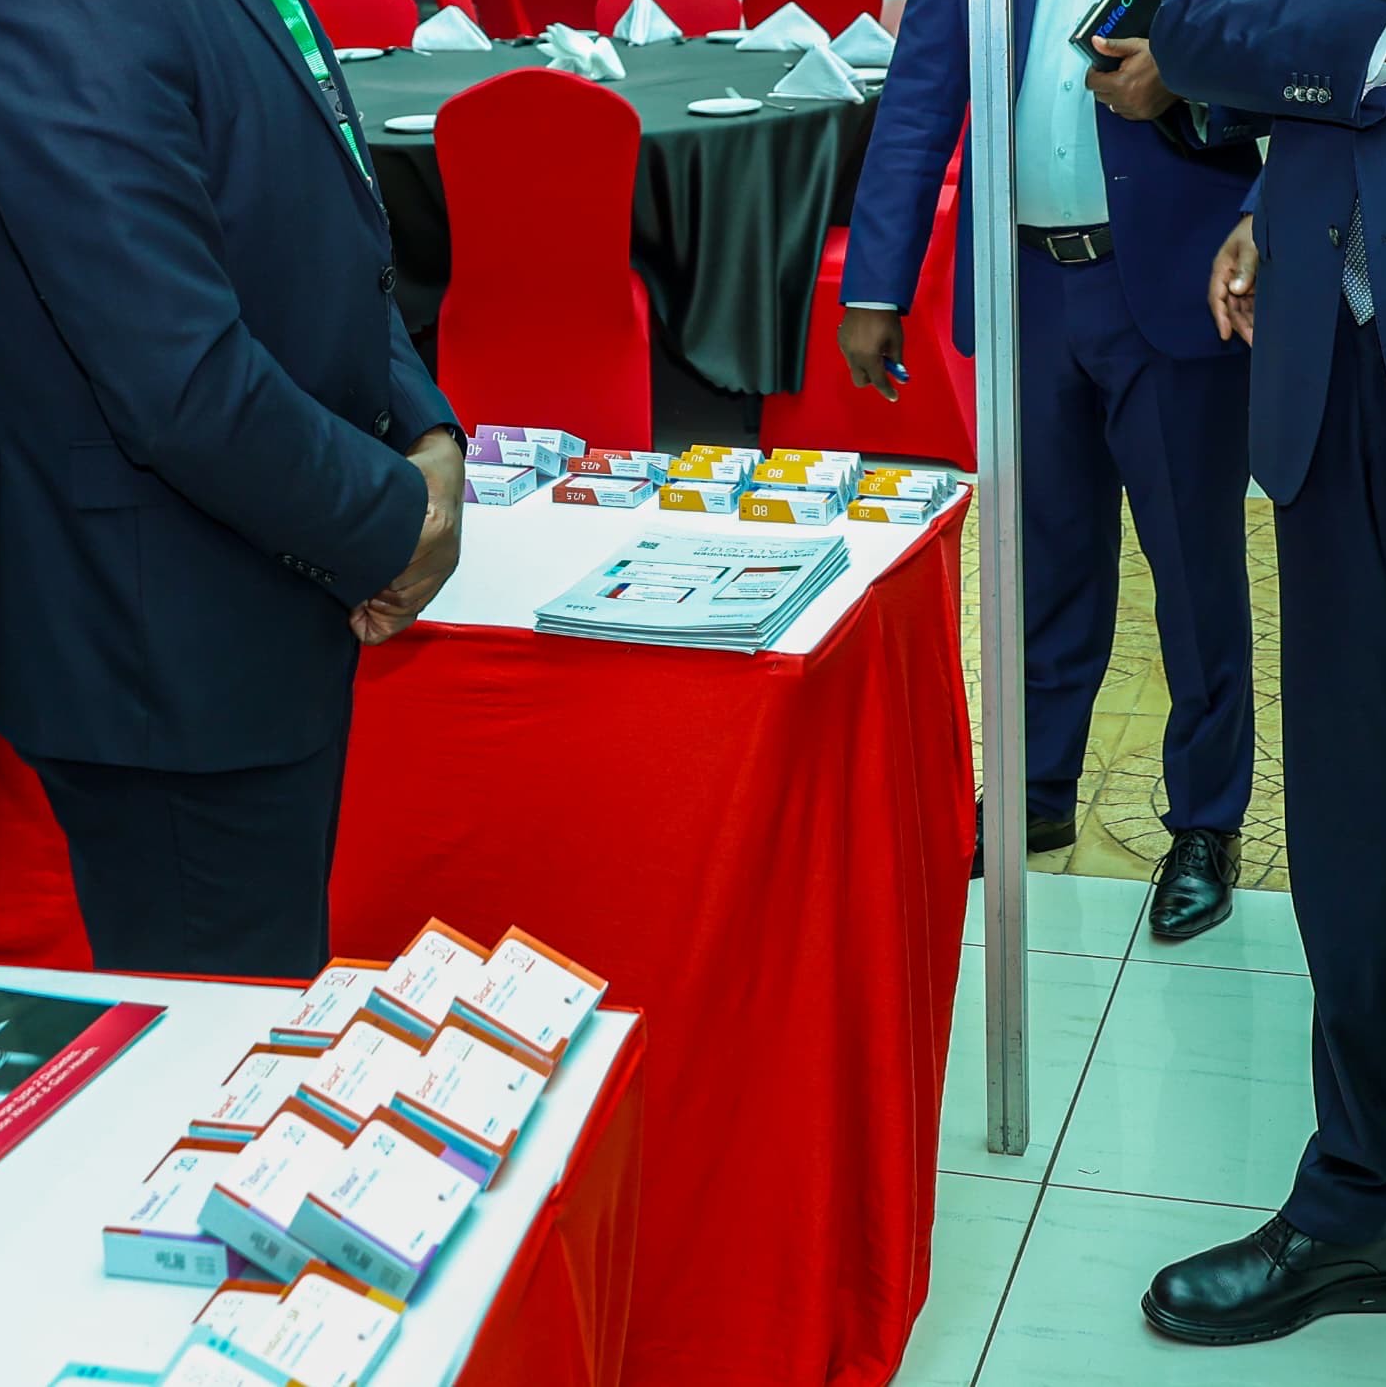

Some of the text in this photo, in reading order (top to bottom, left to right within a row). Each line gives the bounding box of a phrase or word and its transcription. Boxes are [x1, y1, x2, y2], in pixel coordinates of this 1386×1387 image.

[466, 443, 482, 456] 40
[580, 461, 601, 471] 4/2.5
[679, 462, 693, 472] 40
[767, 468, 783, 478] 80
[869, 483, 880, 492] 20
[566, 491, 587, 501] 4/2.5
[669, 492, 683, 503] 40
[752, 504, 768, 517] 80
[858, 509, 870, 518] 20
[700, 546, 818, 555] CATALOGUE
[505, 946, 530, 968] 50
